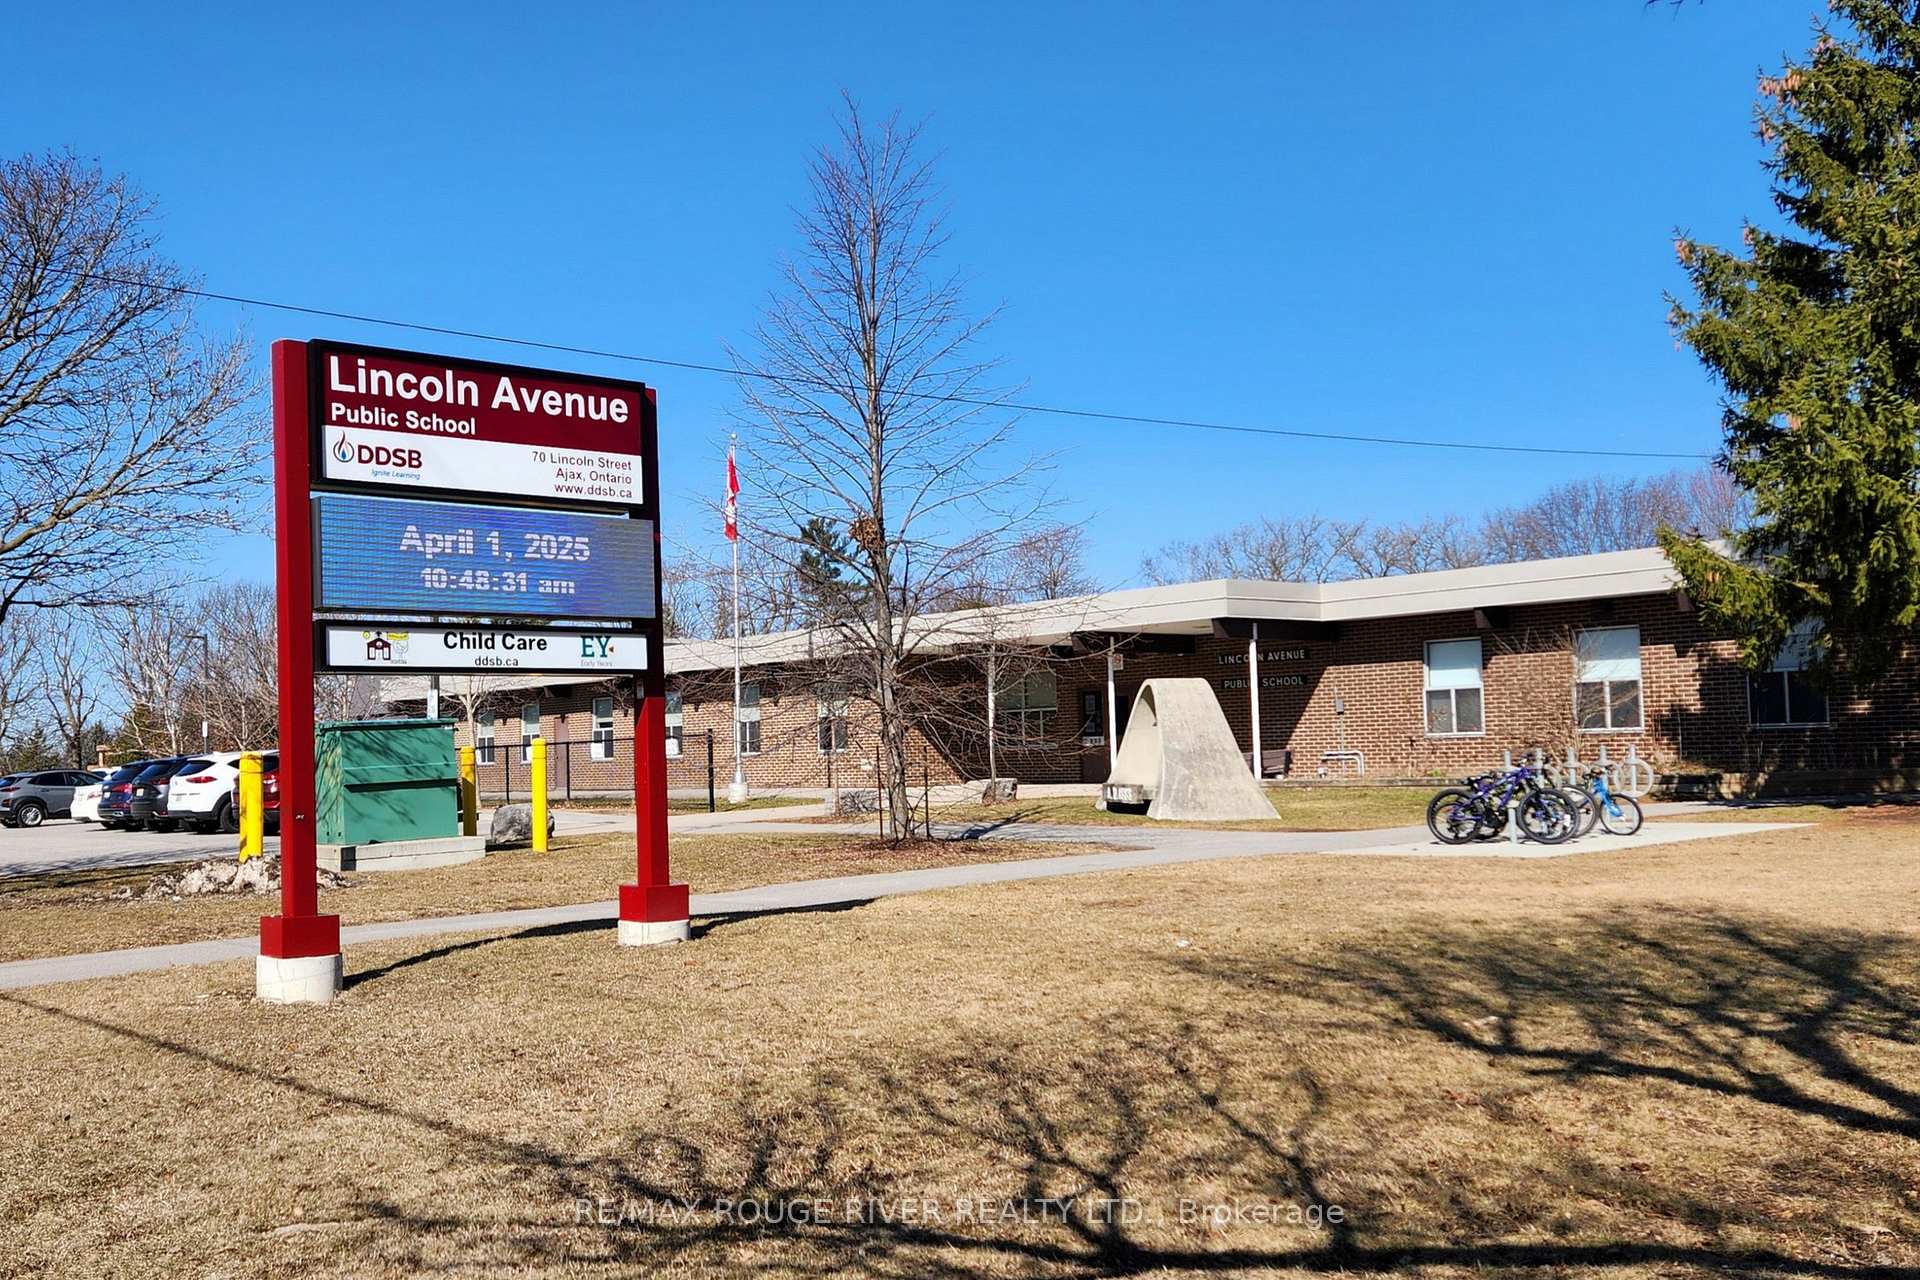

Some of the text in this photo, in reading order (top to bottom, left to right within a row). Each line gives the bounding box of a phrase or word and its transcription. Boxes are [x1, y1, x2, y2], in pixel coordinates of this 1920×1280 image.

[330, 355, 629, 424] Lincoln Avenue
[331, 402, 476, 435] Public School
[357, 444, 423, 469] DDSB
[532, 450, 632, 471] 70 Lincoln Street
[555, 467, 632, 484] Ajax, Ontario
[554, 483, 632, 498] www.ddsb.ca
[399, 524, 591, 562] April 1, 2025
[420, 567, 576, 595] 10:48:31 am
[443, 630, 548, 651] Child Care
[580, 635, 612, 658] EY
[474, 655, 519, 667] ddsb.ca
[1267, 649, 1305, 661] AVENUE
[1262, 676, 1304, 687] SCHOOL
